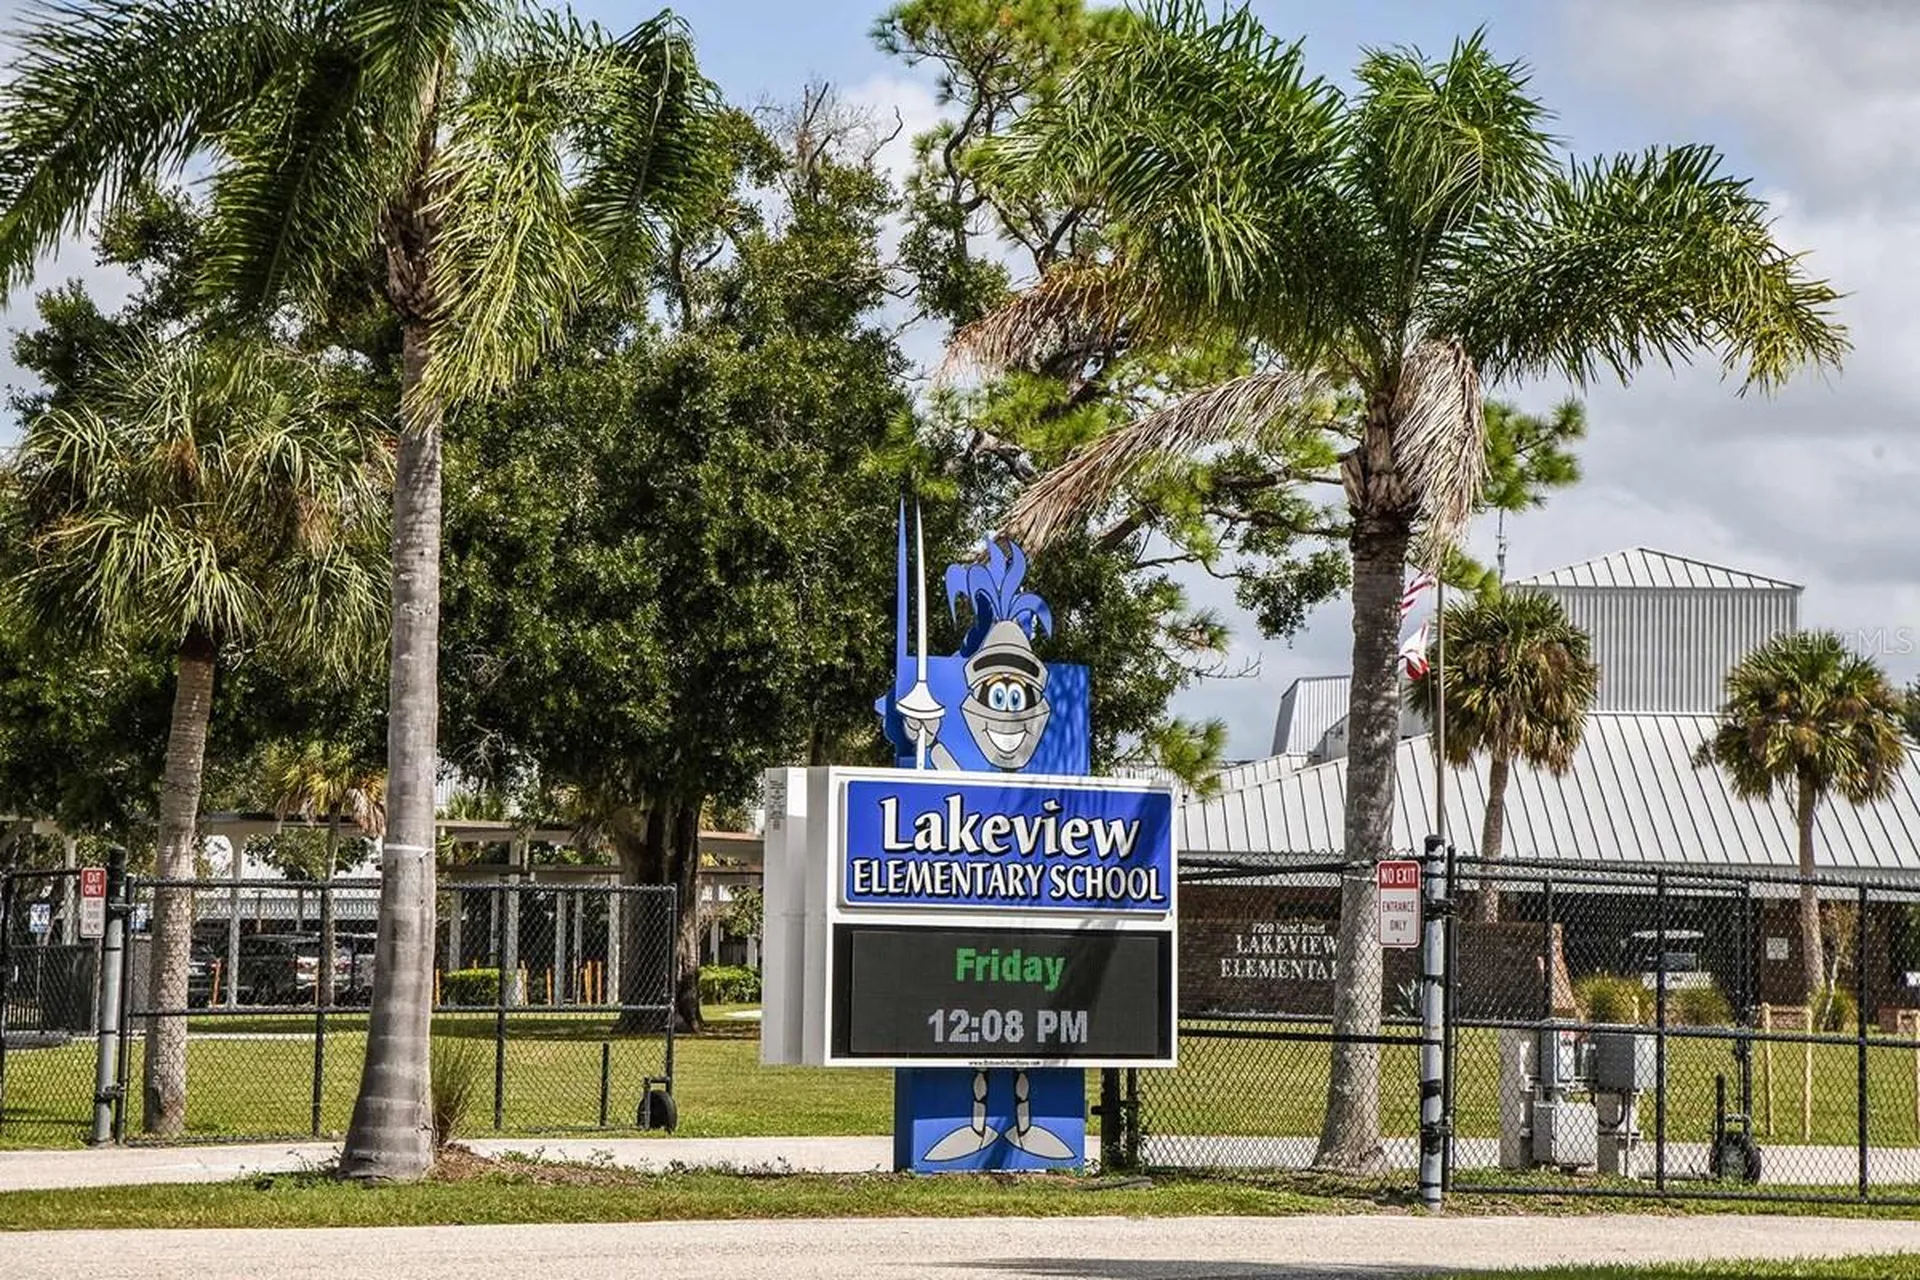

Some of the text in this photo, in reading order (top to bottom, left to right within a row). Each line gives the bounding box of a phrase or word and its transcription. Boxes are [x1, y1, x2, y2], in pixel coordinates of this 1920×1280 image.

[879, 794, 1141, 859] Lakeview
[851, 858, 1165, 901] ELEMENTARY SCHOOL
[1381, 868, 1416, 884] NO EXIT
[1236, 934, 1340, 955] LAKEVIEW
[956, 948, 1065, 991] Friday
[928, 1009, 1088, 1043] 12:08 PM
